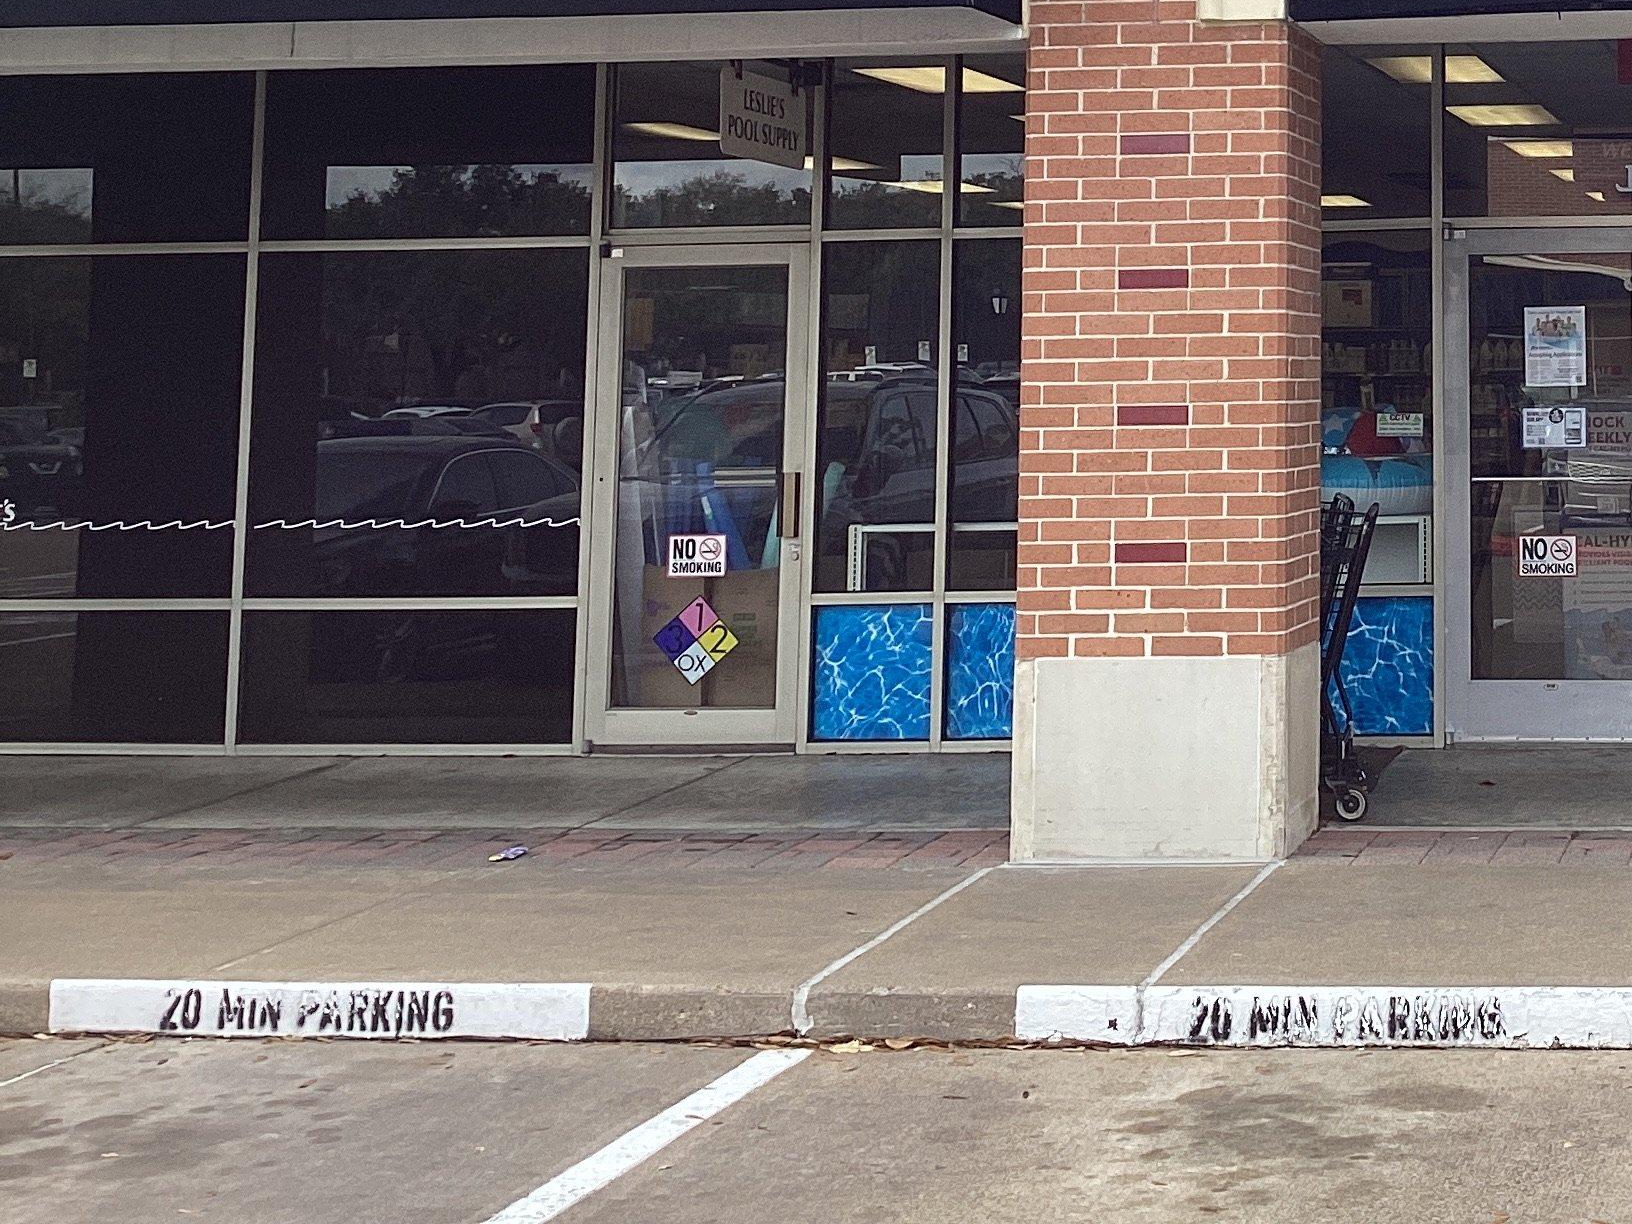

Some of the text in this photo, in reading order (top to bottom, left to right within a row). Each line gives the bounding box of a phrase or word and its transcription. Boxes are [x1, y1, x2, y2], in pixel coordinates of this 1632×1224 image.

[743, 88, 785, 120] LESLIE'S
[728, 114, 799, 152] POOL SUPPLY
[1587, 417, 1626, 429] OCK
[1587, 431, 1632, 444] EEKLY
[672, 538, 697, 560] NO
[1521, 537, 1548, 561] NO
[671, 561, 722, 574] SMOKING
[1521, 562, 1575, 575] SMOKING
[695, 602, 704, 632] 1
[665, 625, 683, 654] 3
[709, 624, 728, 654] 2
[678, 654, 707, 673] OX
[159, 988, 454, 1033] 20 MIN PARKING
[1188, 993, 1507, 1042] 20 MIN PARKING
